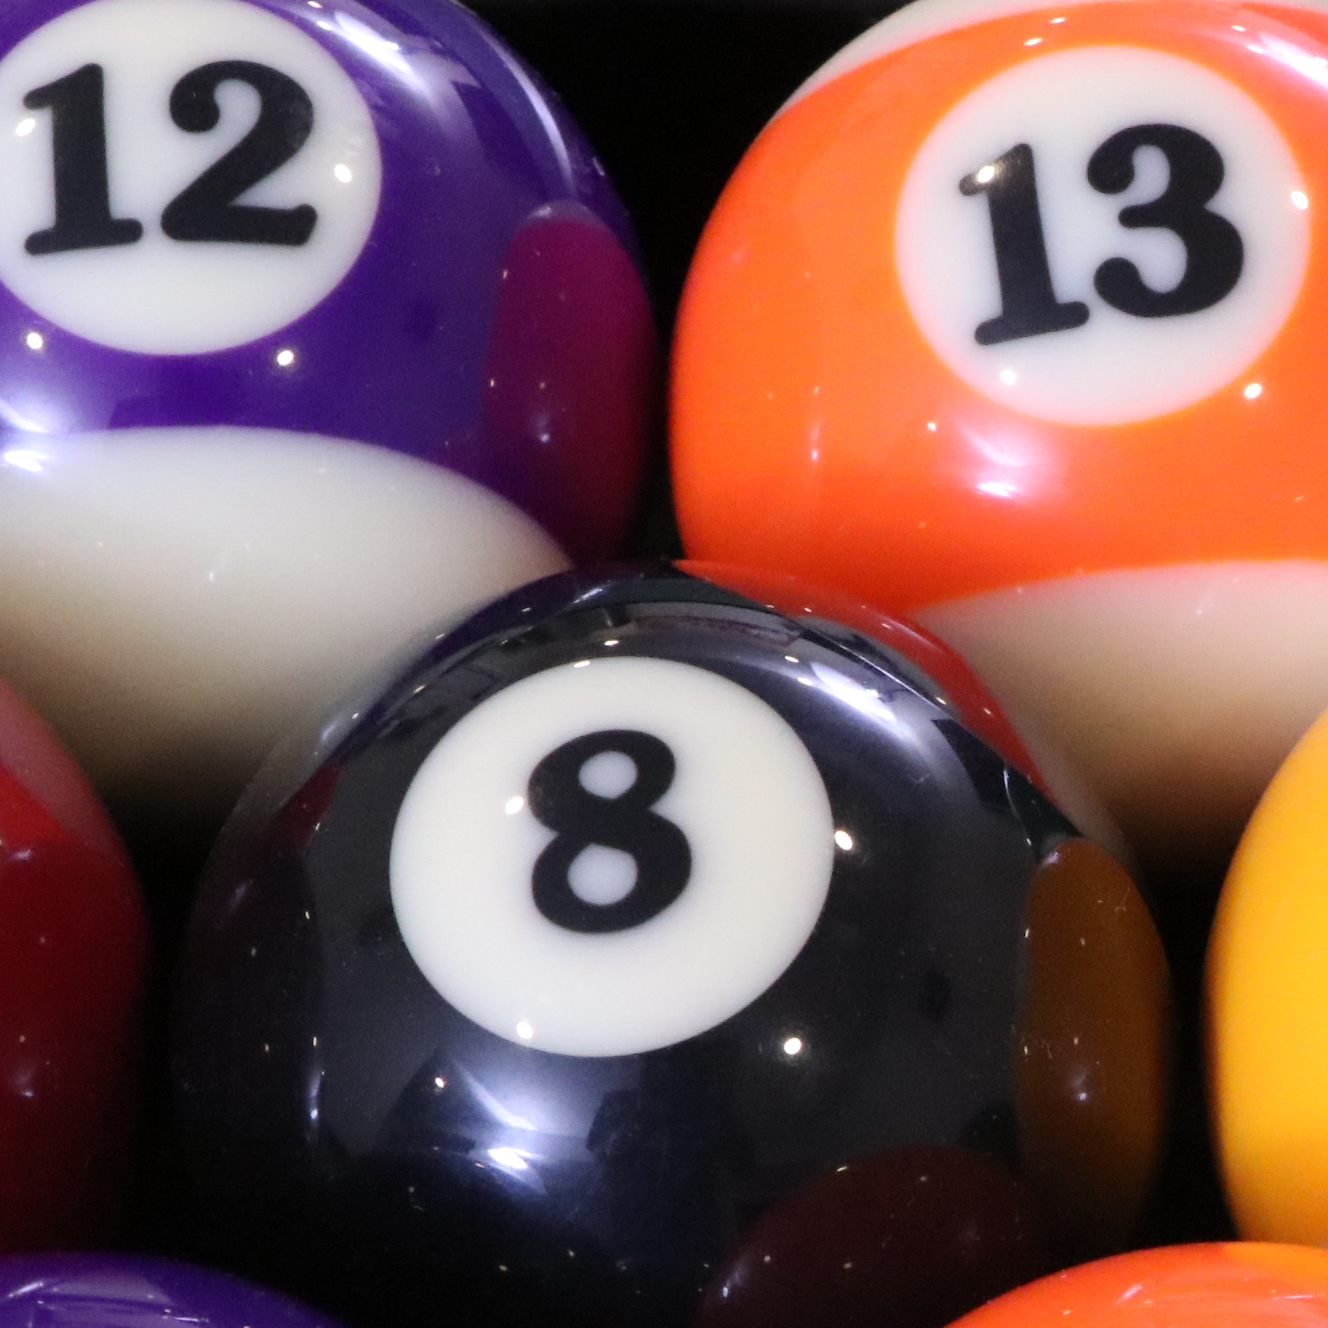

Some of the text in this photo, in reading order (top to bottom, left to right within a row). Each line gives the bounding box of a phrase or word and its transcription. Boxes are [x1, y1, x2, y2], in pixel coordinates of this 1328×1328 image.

[24, 60, 318, 255] 12
[960, 122, 1244, 345] 13
[528, 730, 693, 935] 8
